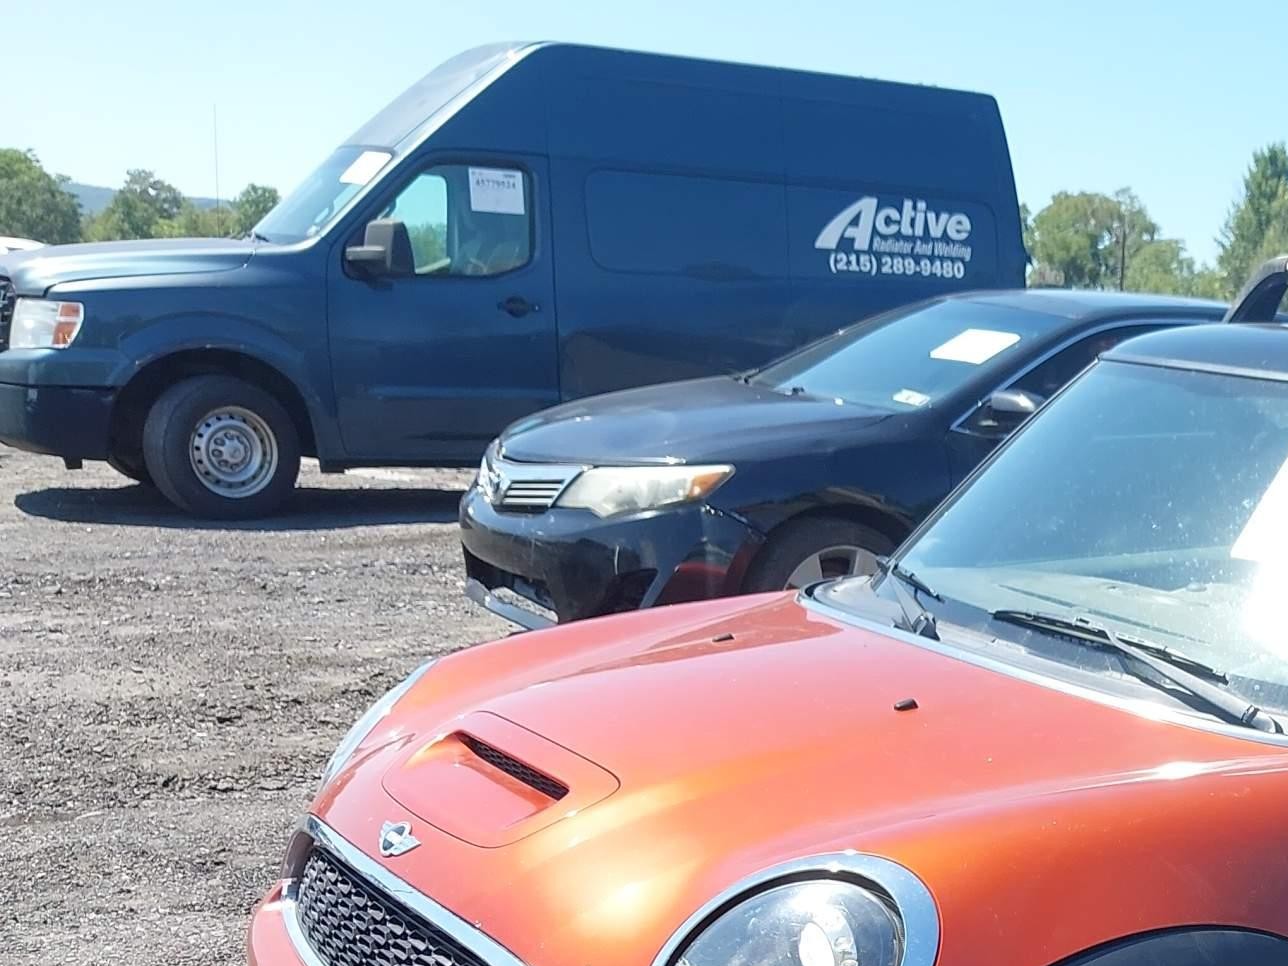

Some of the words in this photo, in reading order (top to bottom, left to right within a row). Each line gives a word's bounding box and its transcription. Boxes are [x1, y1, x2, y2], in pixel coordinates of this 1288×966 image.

[814, 195, 972, 251] Active
[872, 235, 914, 254] Radiator
[914, 238, 933, 255] And
[934, 241, 971, 262] Welding
[829, 252, 877, 275] (215)
[881, 256, 965, 279] 289-9480
